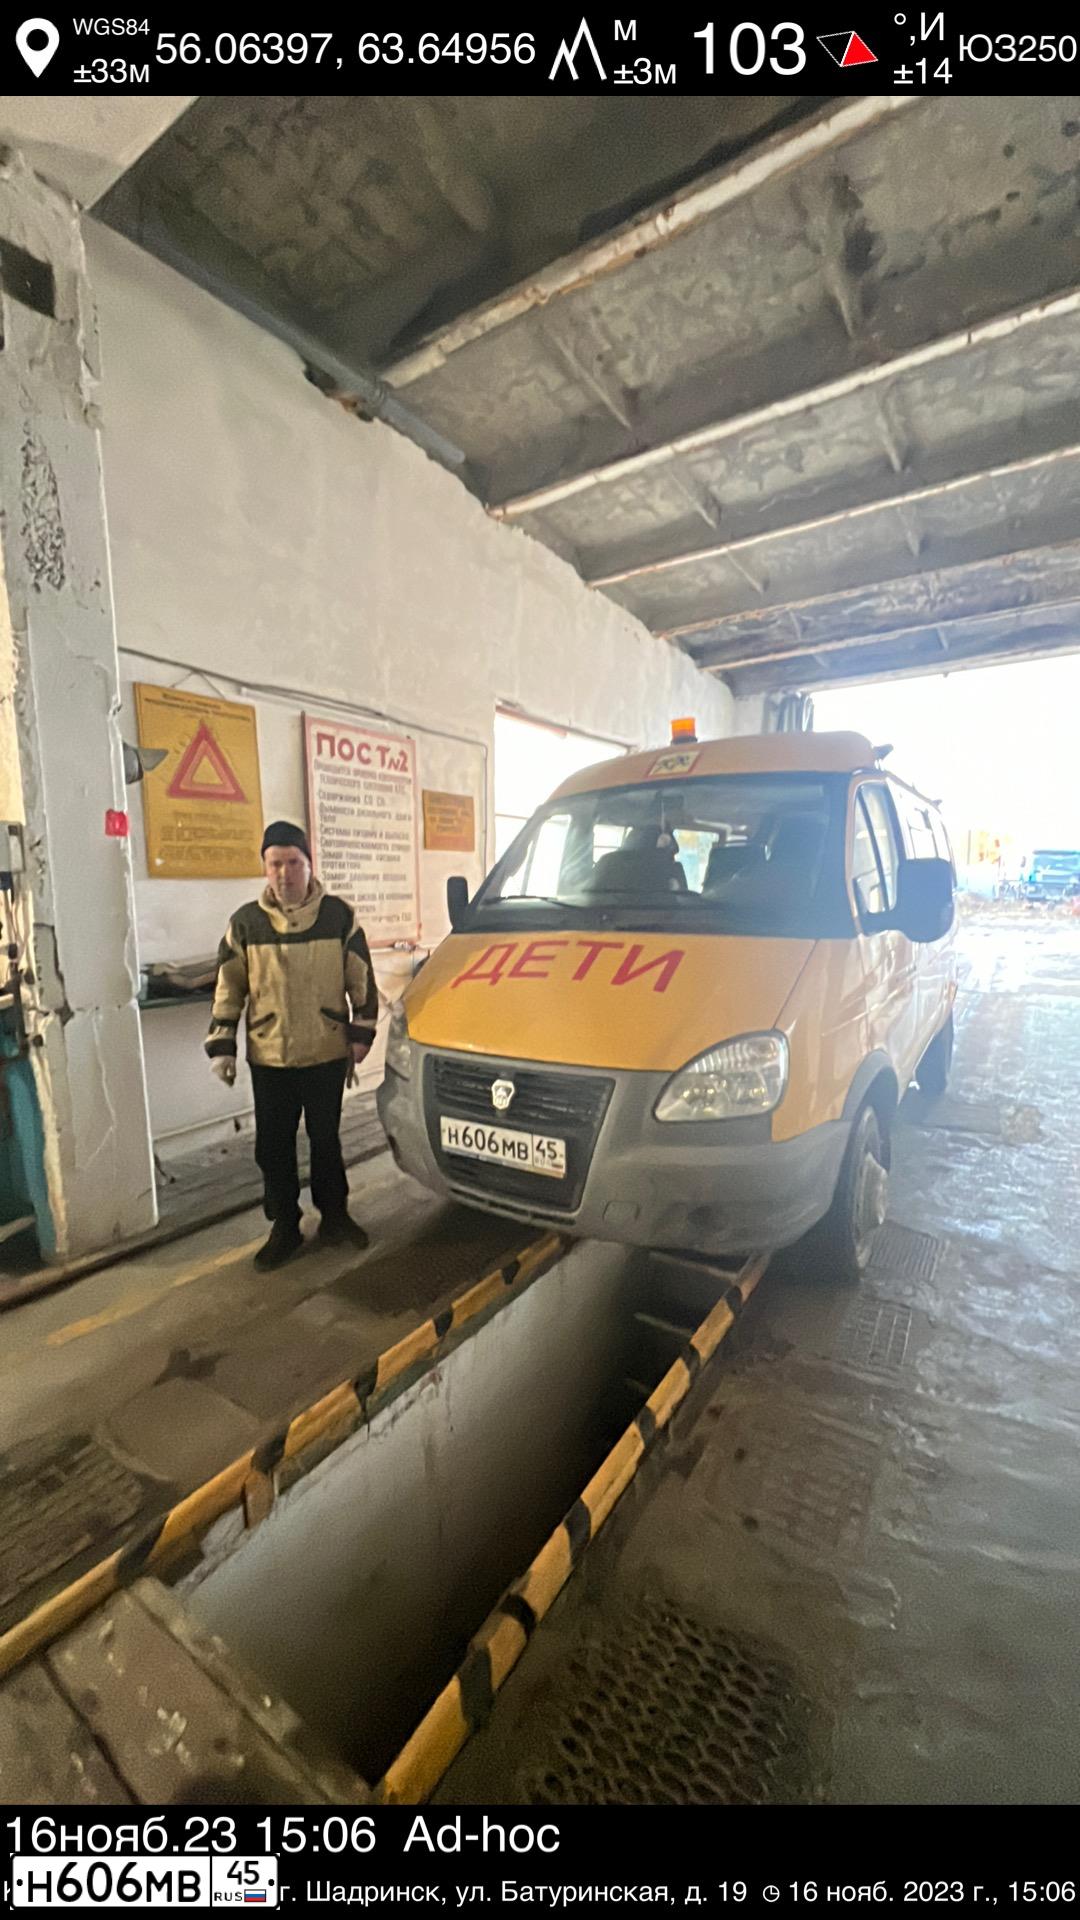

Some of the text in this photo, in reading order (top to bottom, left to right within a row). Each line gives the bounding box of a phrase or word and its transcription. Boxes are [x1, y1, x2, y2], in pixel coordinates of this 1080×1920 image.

[316, 732, 391, 769] ПОСТ
[451, 940, 685, 993] ДЕТИ
[448, 1126, 557, 1160] Н606МВ 45
